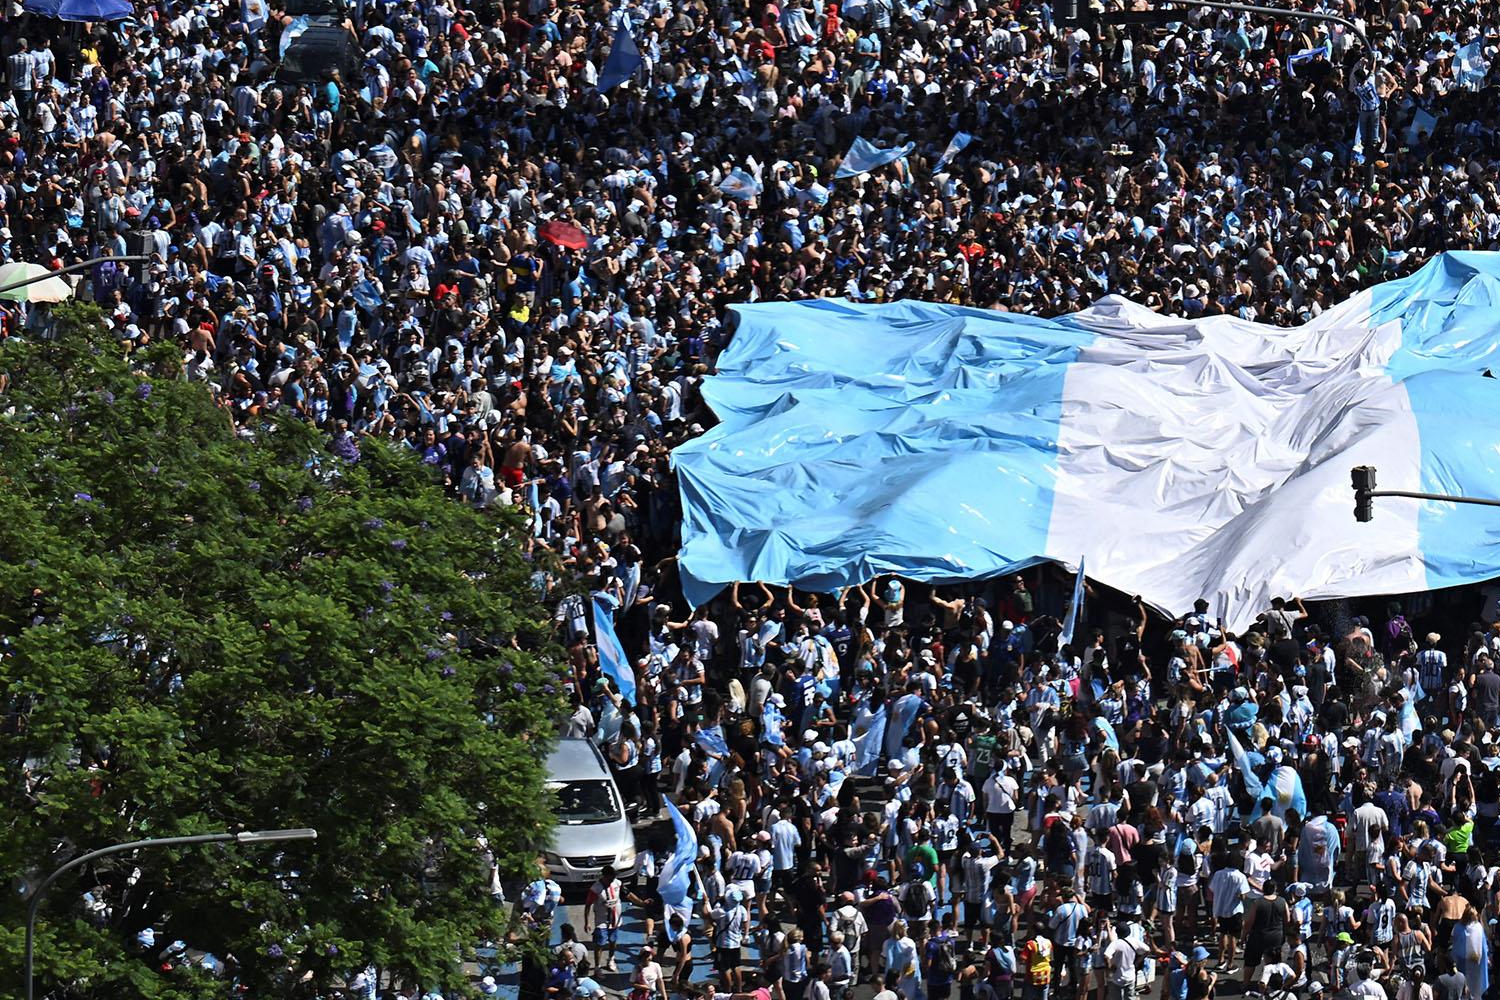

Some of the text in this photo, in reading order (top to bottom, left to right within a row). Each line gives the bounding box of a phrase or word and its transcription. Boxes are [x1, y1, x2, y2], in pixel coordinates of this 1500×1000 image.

[838, 643, 848, 657] 9
[977, 748, 991, 763] 23
[1380, 914, 1389, 929] 9
